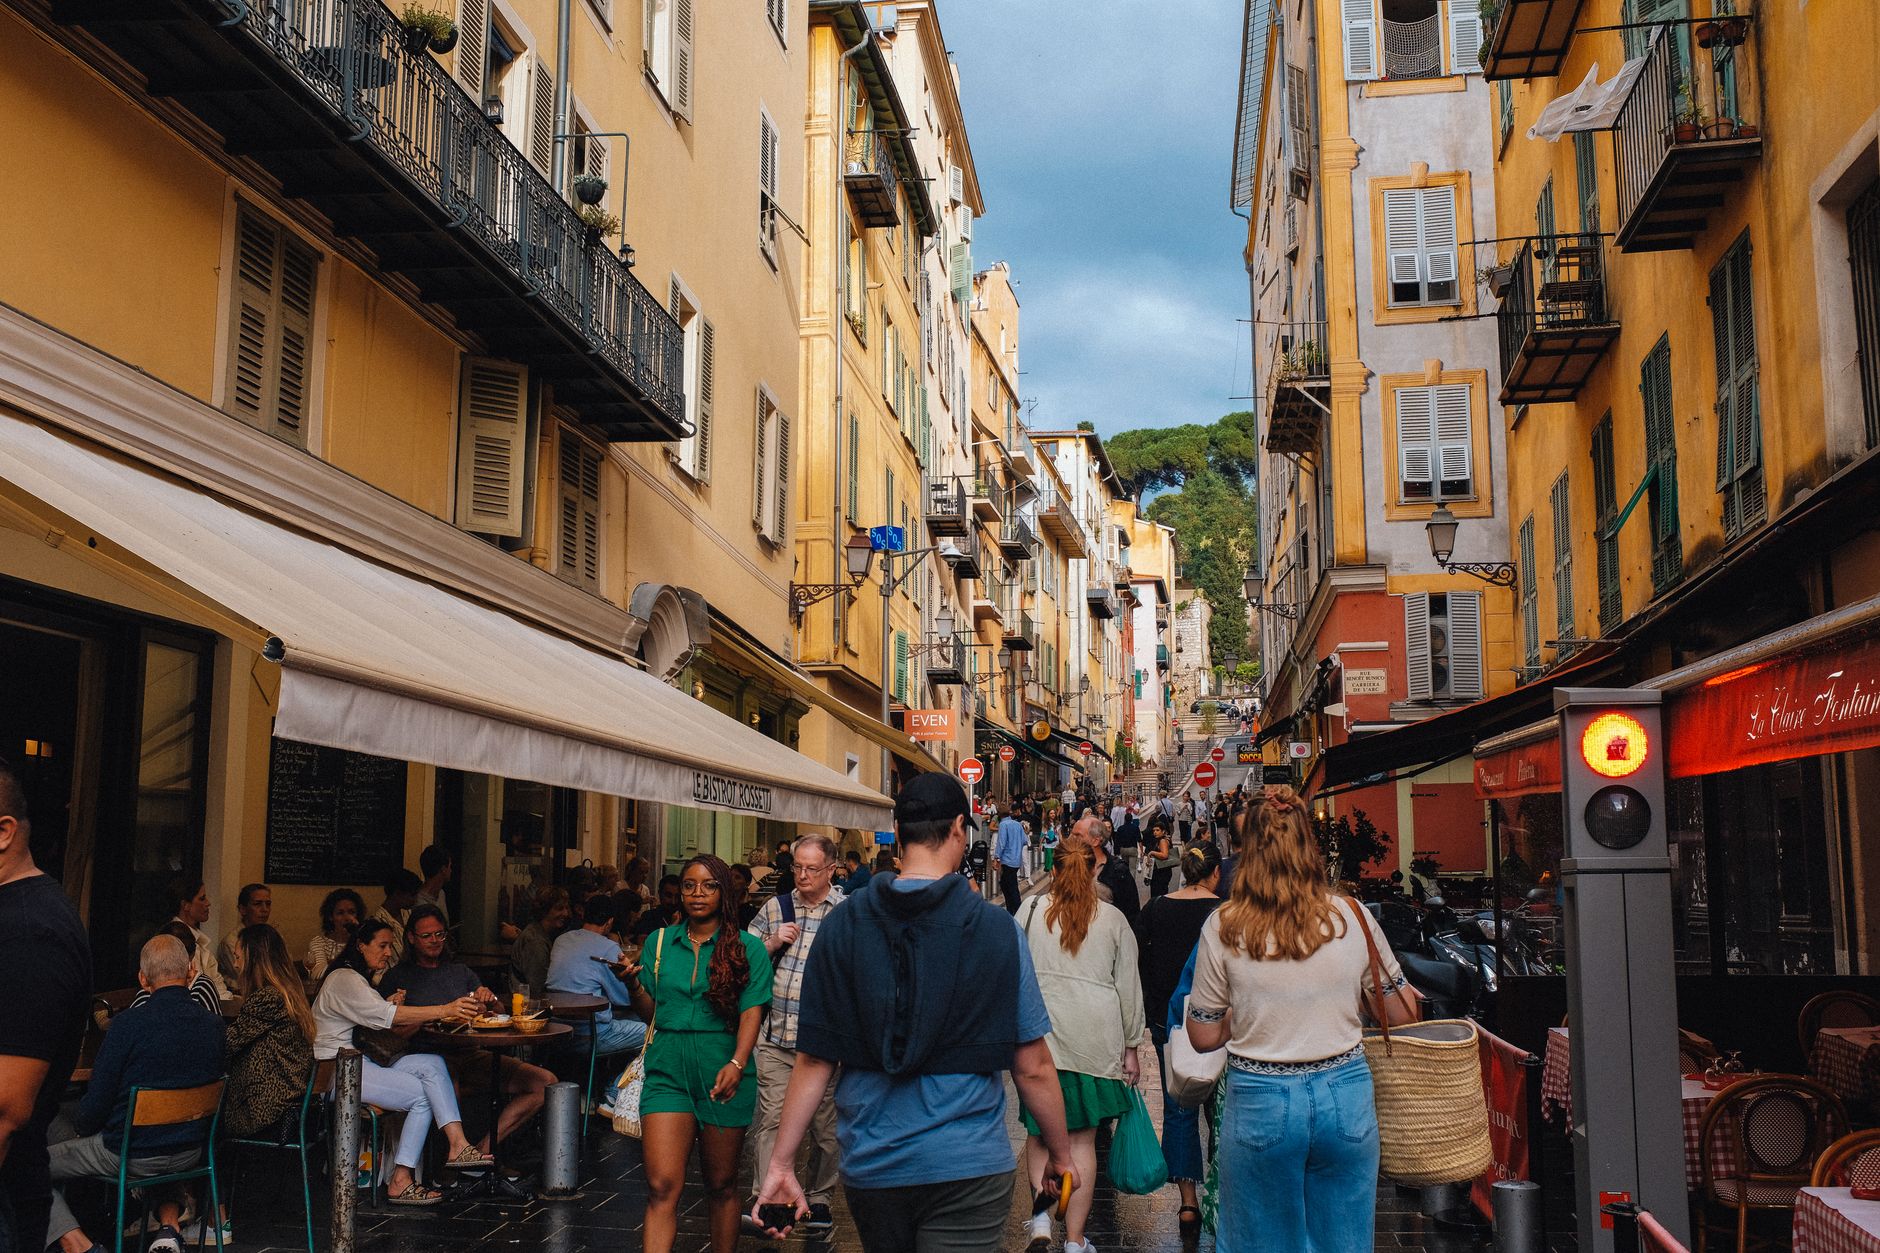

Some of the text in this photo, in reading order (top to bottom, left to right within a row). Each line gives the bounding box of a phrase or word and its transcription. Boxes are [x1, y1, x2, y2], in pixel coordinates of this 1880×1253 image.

[871, 528, 886, 549] SOS
[888, 526, 901, 550] SOS
[911, 714, 948, 726] EVEN
[1770, 686, 1807, 736] Claire
[1239, 753, 1263, 762] SOCCA
[692, 771, 772, 811] LE BISTROT ROSSETTI
